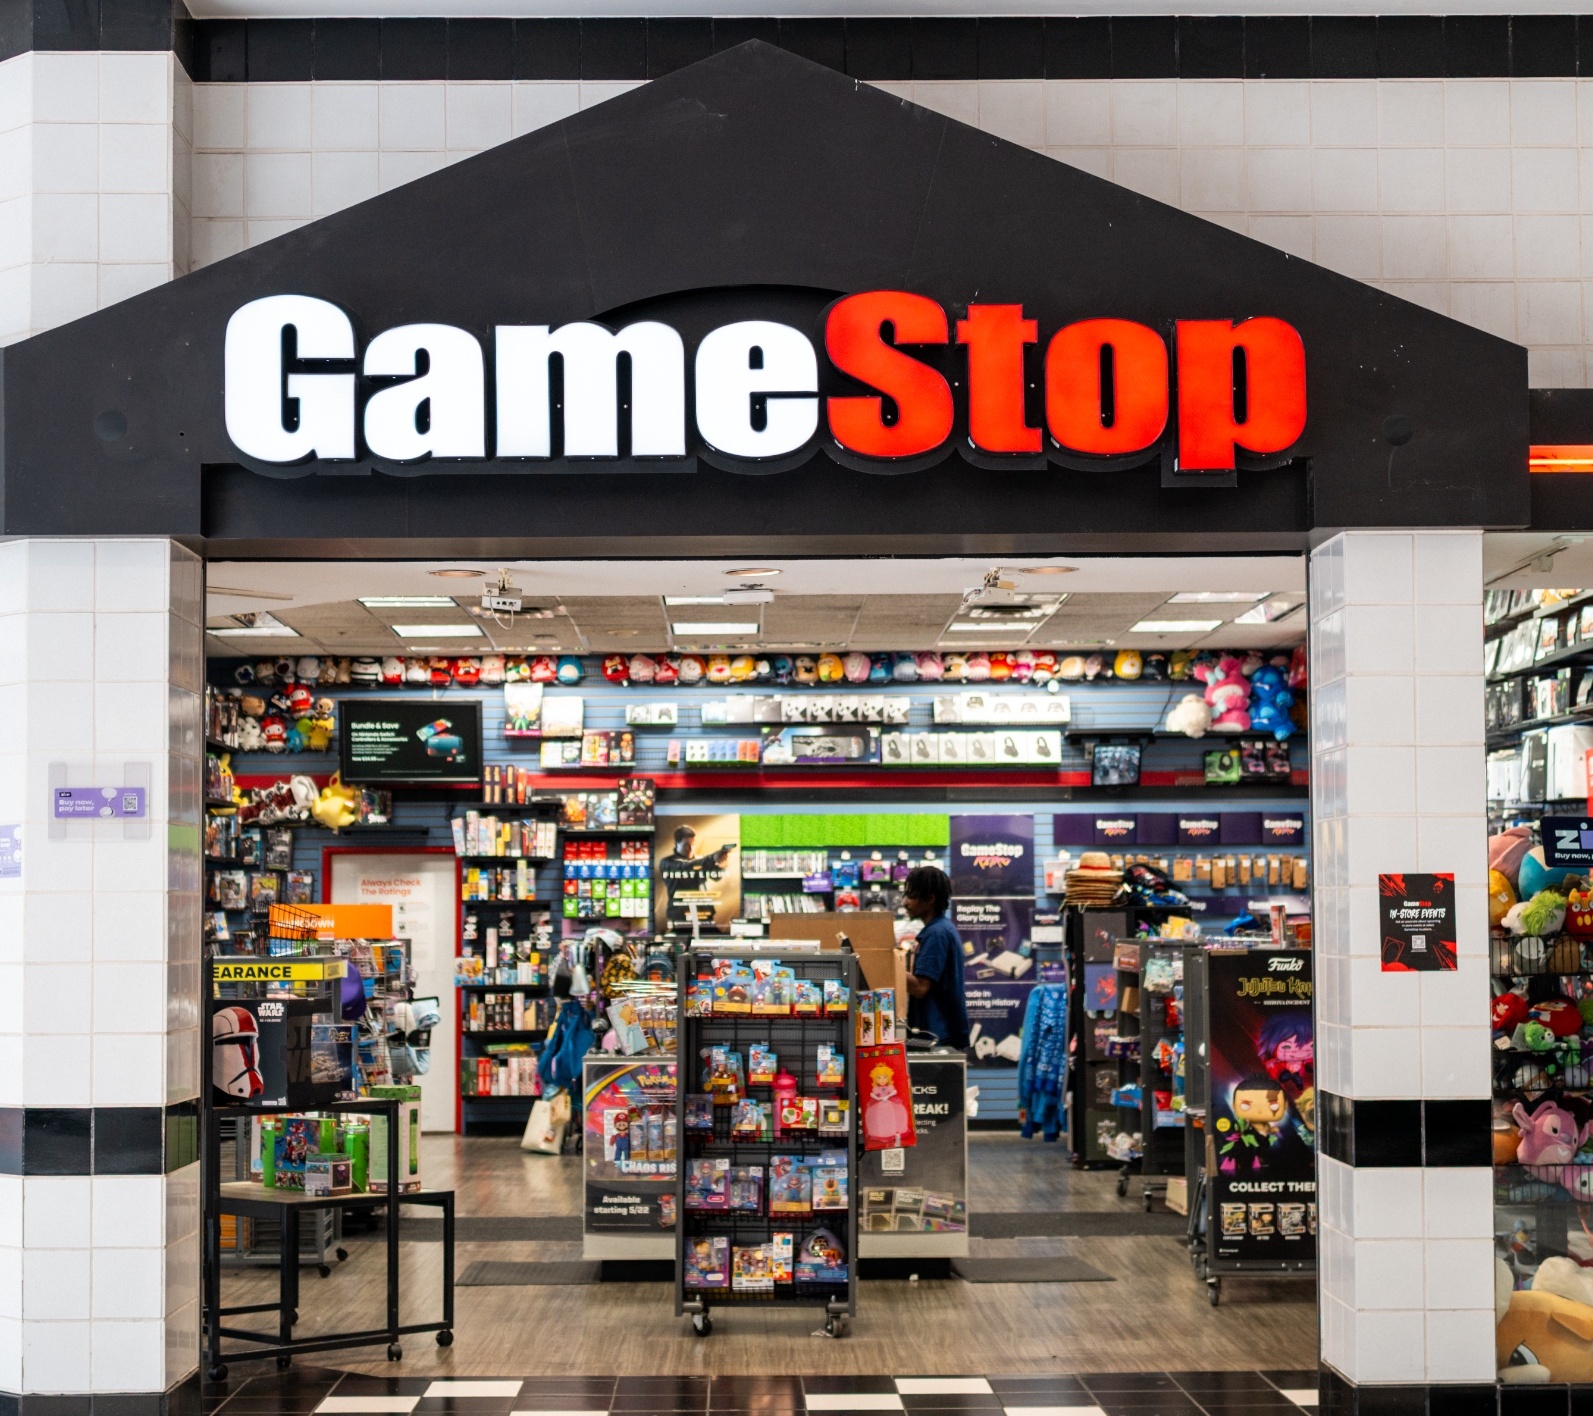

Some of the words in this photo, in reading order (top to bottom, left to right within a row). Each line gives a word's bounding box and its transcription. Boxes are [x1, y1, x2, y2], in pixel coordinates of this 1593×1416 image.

[223, 289, 1309, 471] GameStop
[1096, 819, 1136, 830] GameStop
[1180, 819, 1218, 830] GameStop
[1264, 819, 1303, 830] GameStop
[961, 843, 1024, 858] GameStop
[1555, 852, 1570, 860] Buy
[361, 879, 392, 887] Always
[394, 878, 421, 886] Check
[361, 888, 376, 896] The
[378, 888, 411, 897] Ratings
[956, 905, 985, 914] Replay
[1390, 908, 1420, 919] IN-STORE
[1421, 908, 1446, 919] EVENTS
[956, 914, 978, 923] Glory
[979, 914, 1000, 923] Days
[1268, 957, 1305, 972] Funko
[213, 966, 292, 978] EARANCE
[258, 1002, 284, 1010] STAR
[992, 999, 1020, 1008] History
[622, 1160, 657, 1173] CHAOS
[1229, 1182, 1285, 1192] COLLECT
[602, 1196, 641, 1204] Available
[594, 1206, 628, 1216] starting
[628, 1206, 650, 1214] 5/22
